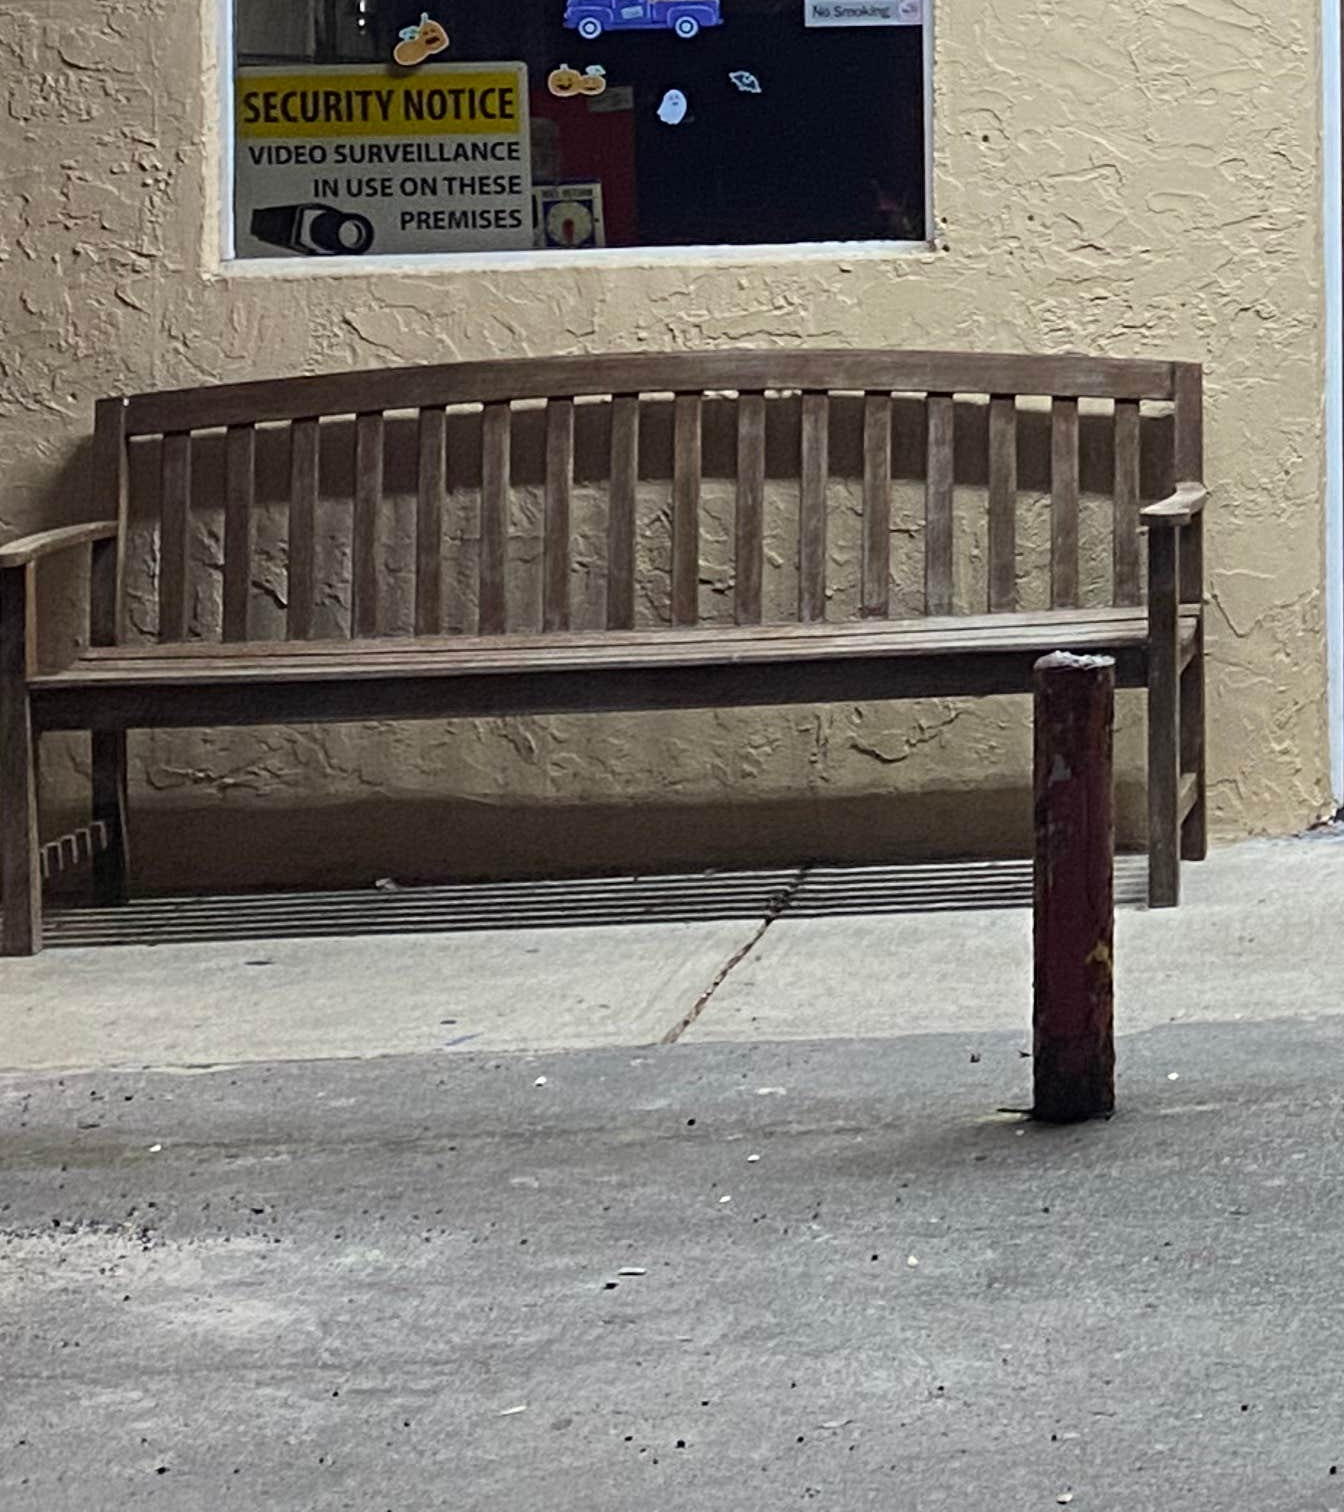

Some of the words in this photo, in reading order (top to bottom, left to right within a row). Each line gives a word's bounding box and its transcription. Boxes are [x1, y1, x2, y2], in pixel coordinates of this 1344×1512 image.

[812, 5, 830, 18] No
[834, 4, 890, 19] Smoking
[243, 90, 395, 123] SECURITY
[404, 88, 515, 121] NOTICE
[249, 145, 327, 165] VIDEO
[334, 142, 520, 164] SURVEILLANCE
[314, 179, 338, 198] IN
[346, 178, 394, 197] USE
[401, 177, 438, 196] ON
[443, 176, 522, 195] THESE
[401, 209, 522, 230] PREMISES
